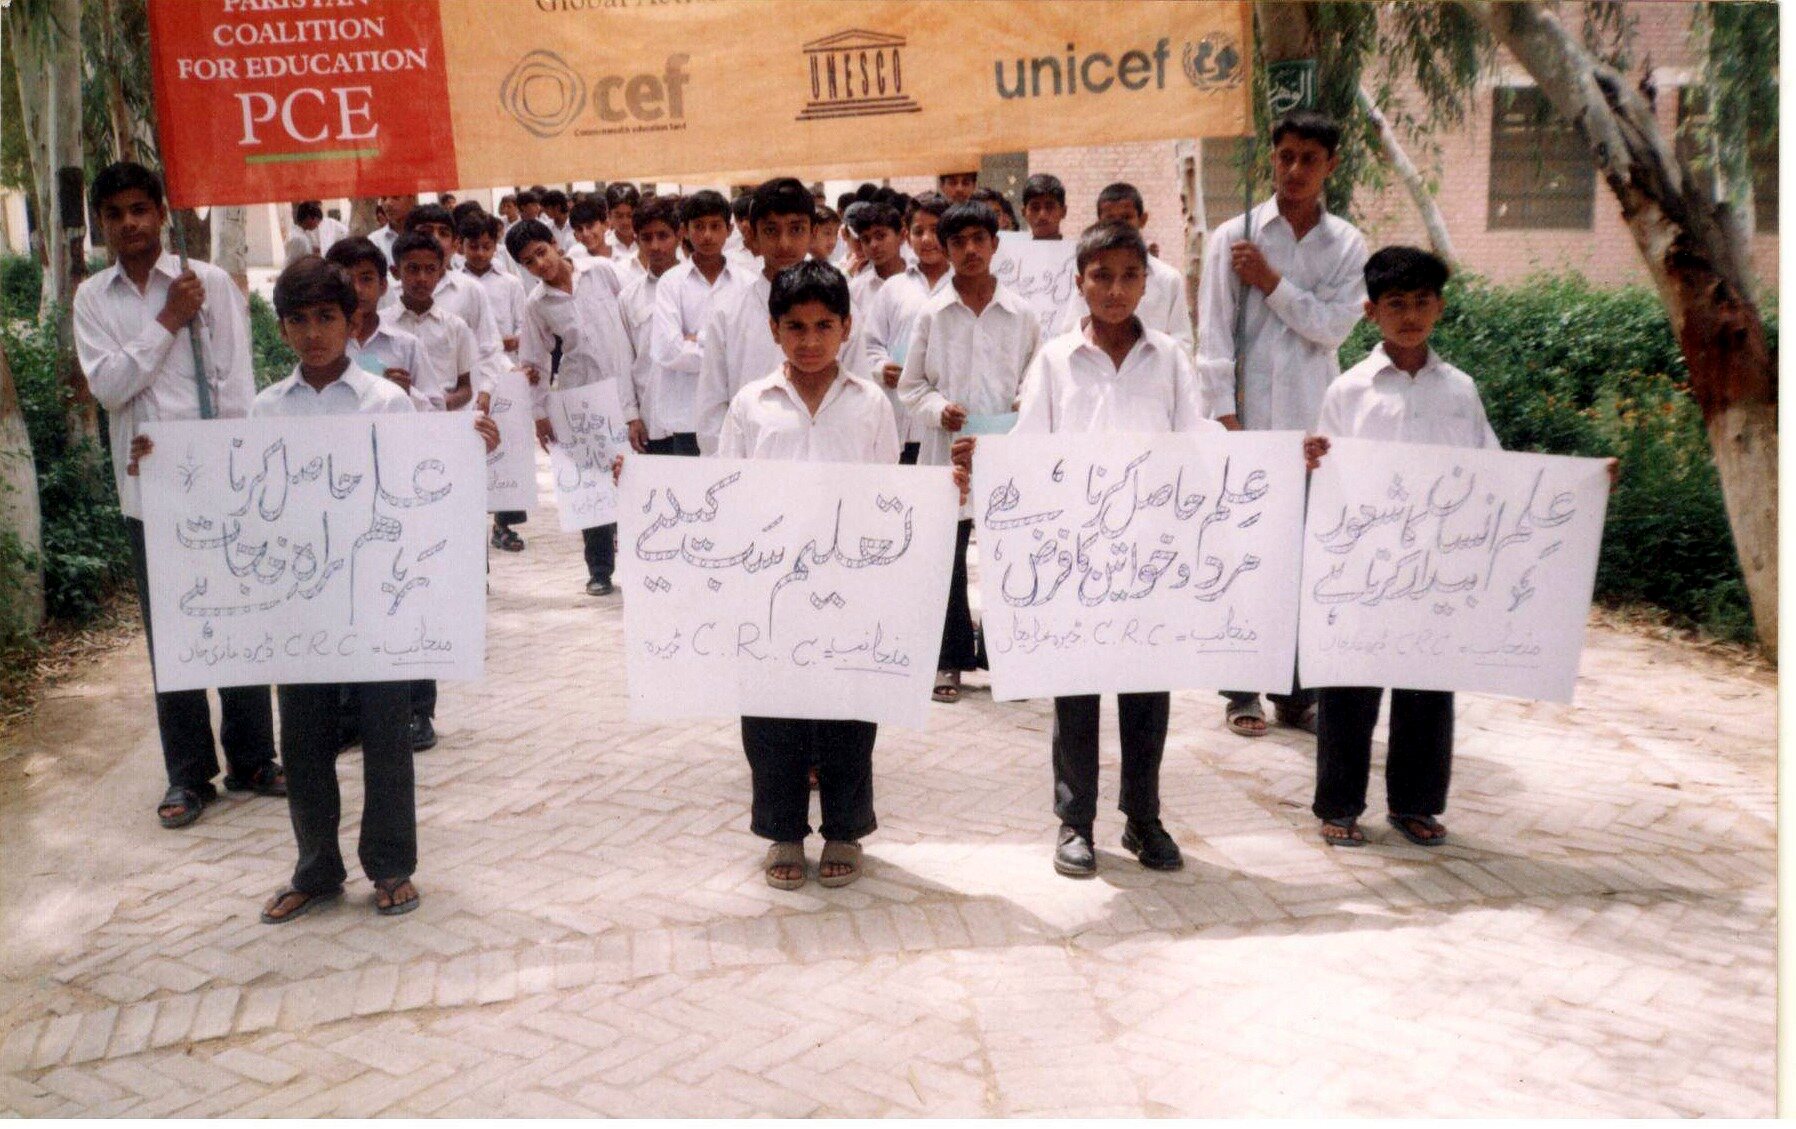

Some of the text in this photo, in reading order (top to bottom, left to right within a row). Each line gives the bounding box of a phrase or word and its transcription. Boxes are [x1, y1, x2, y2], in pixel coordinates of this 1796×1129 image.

[212, 16, 385, 47] COALITION
[223, 0, 369, 12] PAKI
[177, 48, 428, 81] FOR EDUCATION
[592, 52, 690, 122] cef
[808, 48, 904, 101] UNESCO
[994, 37, 1171, 100] unicef
[234, 85, 379, 145] PCE
[768, 493, 913, 641] تعلیم
